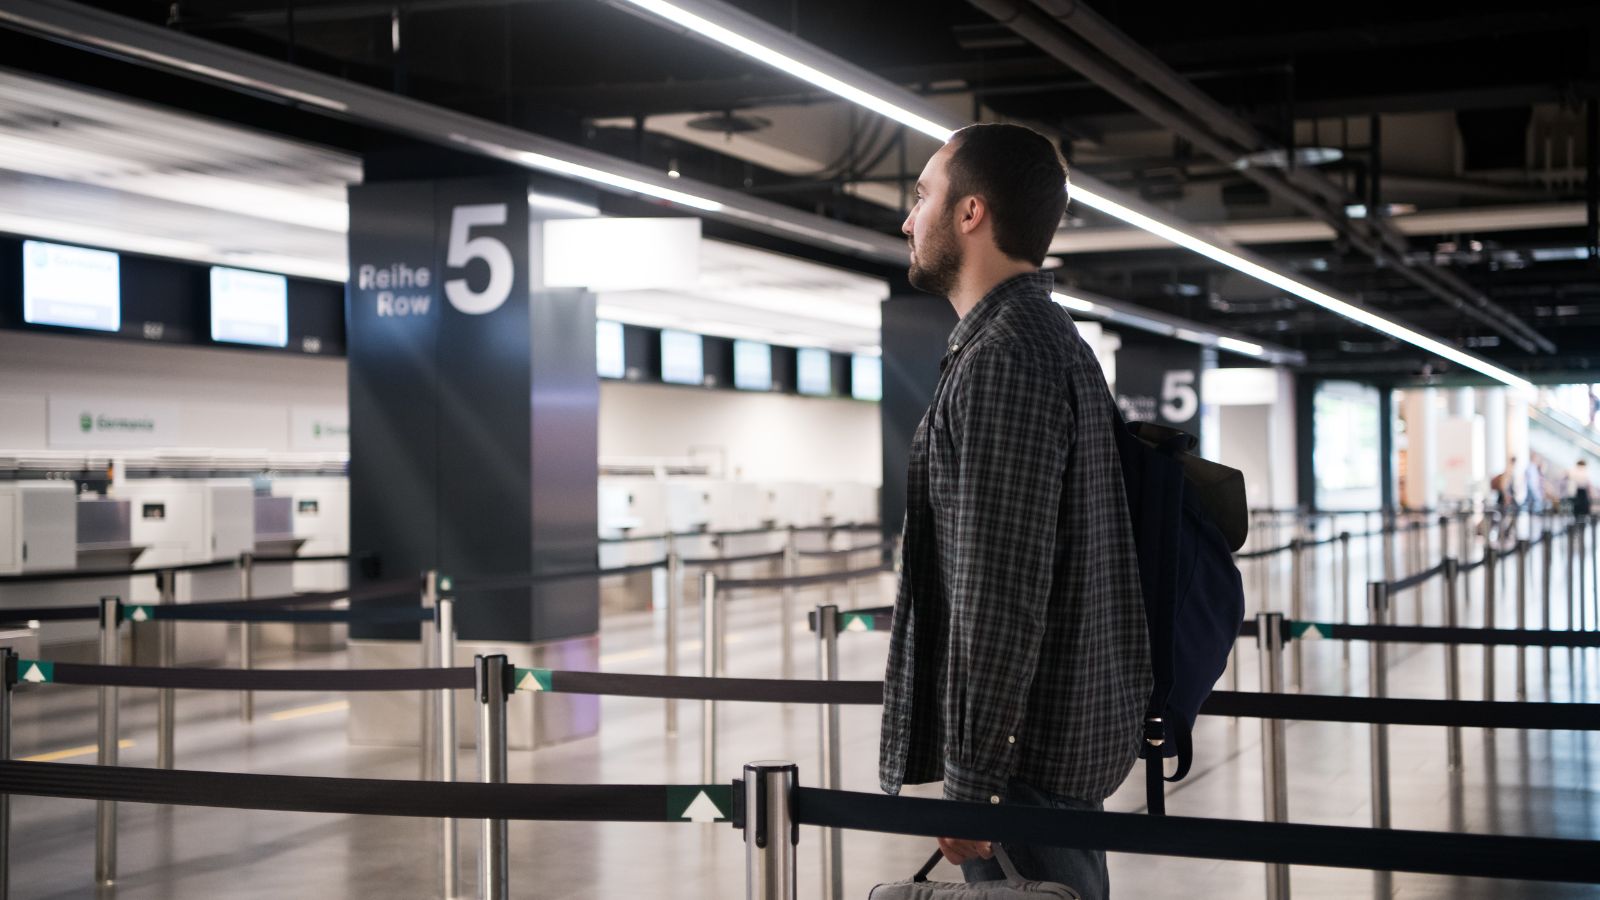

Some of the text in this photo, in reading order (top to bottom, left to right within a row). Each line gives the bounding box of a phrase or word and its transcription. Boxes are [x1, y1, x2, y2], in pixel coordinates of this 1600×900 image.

[359, 263, 431, 290] Reihe
[444, 203, 514, 315] 5
[377, 291, 431, 317] Row
[1161, 369, 1198, 423] 5
